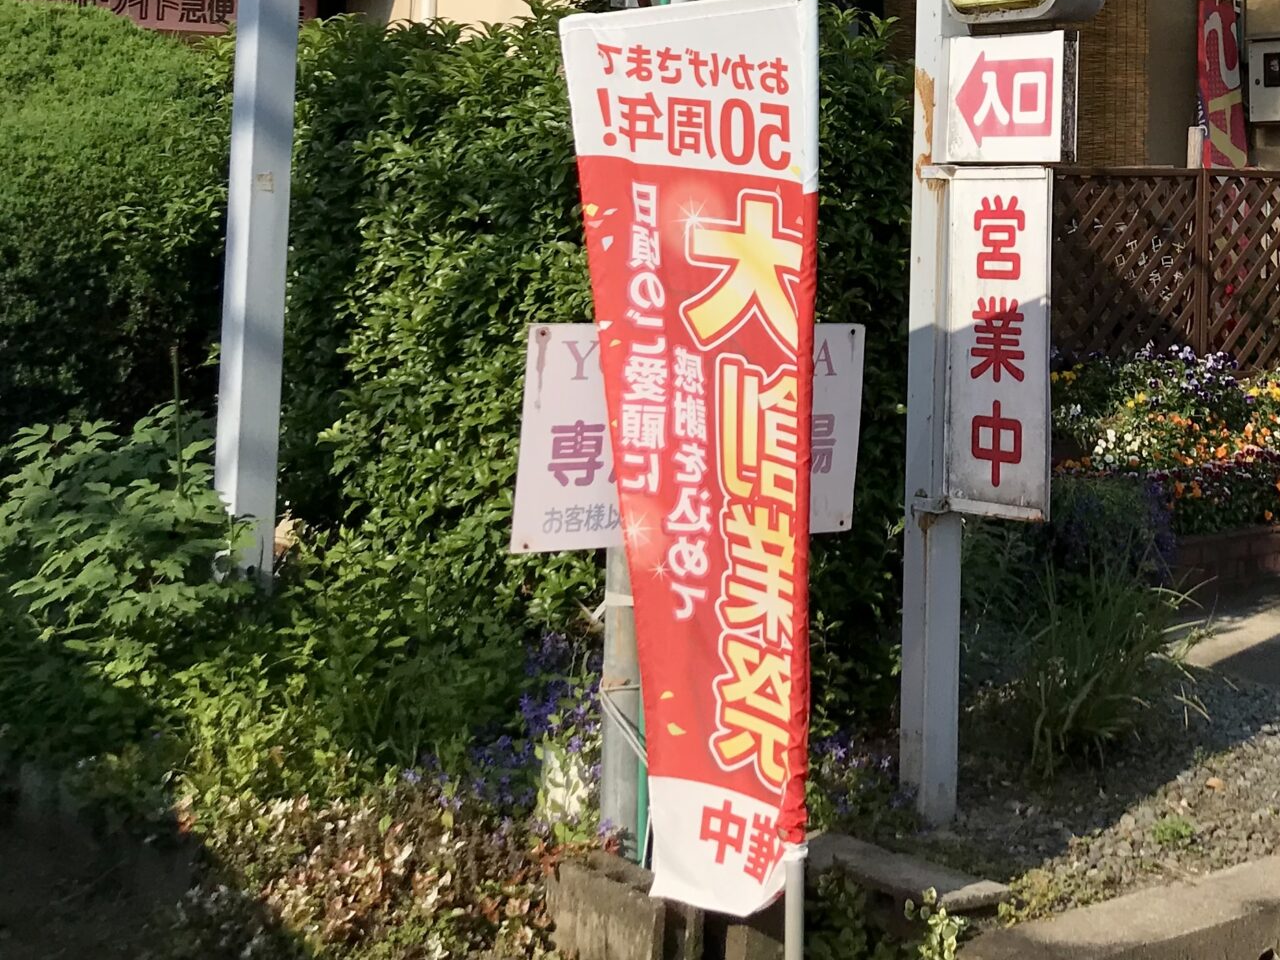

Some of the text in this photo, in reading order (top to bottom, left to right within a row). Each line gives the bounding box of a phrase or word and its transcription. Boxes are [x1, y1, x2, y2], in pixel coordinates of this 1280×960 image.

[973, 70, 1046, 128] 入口
[970, 194, 1026, 488] 営業中
